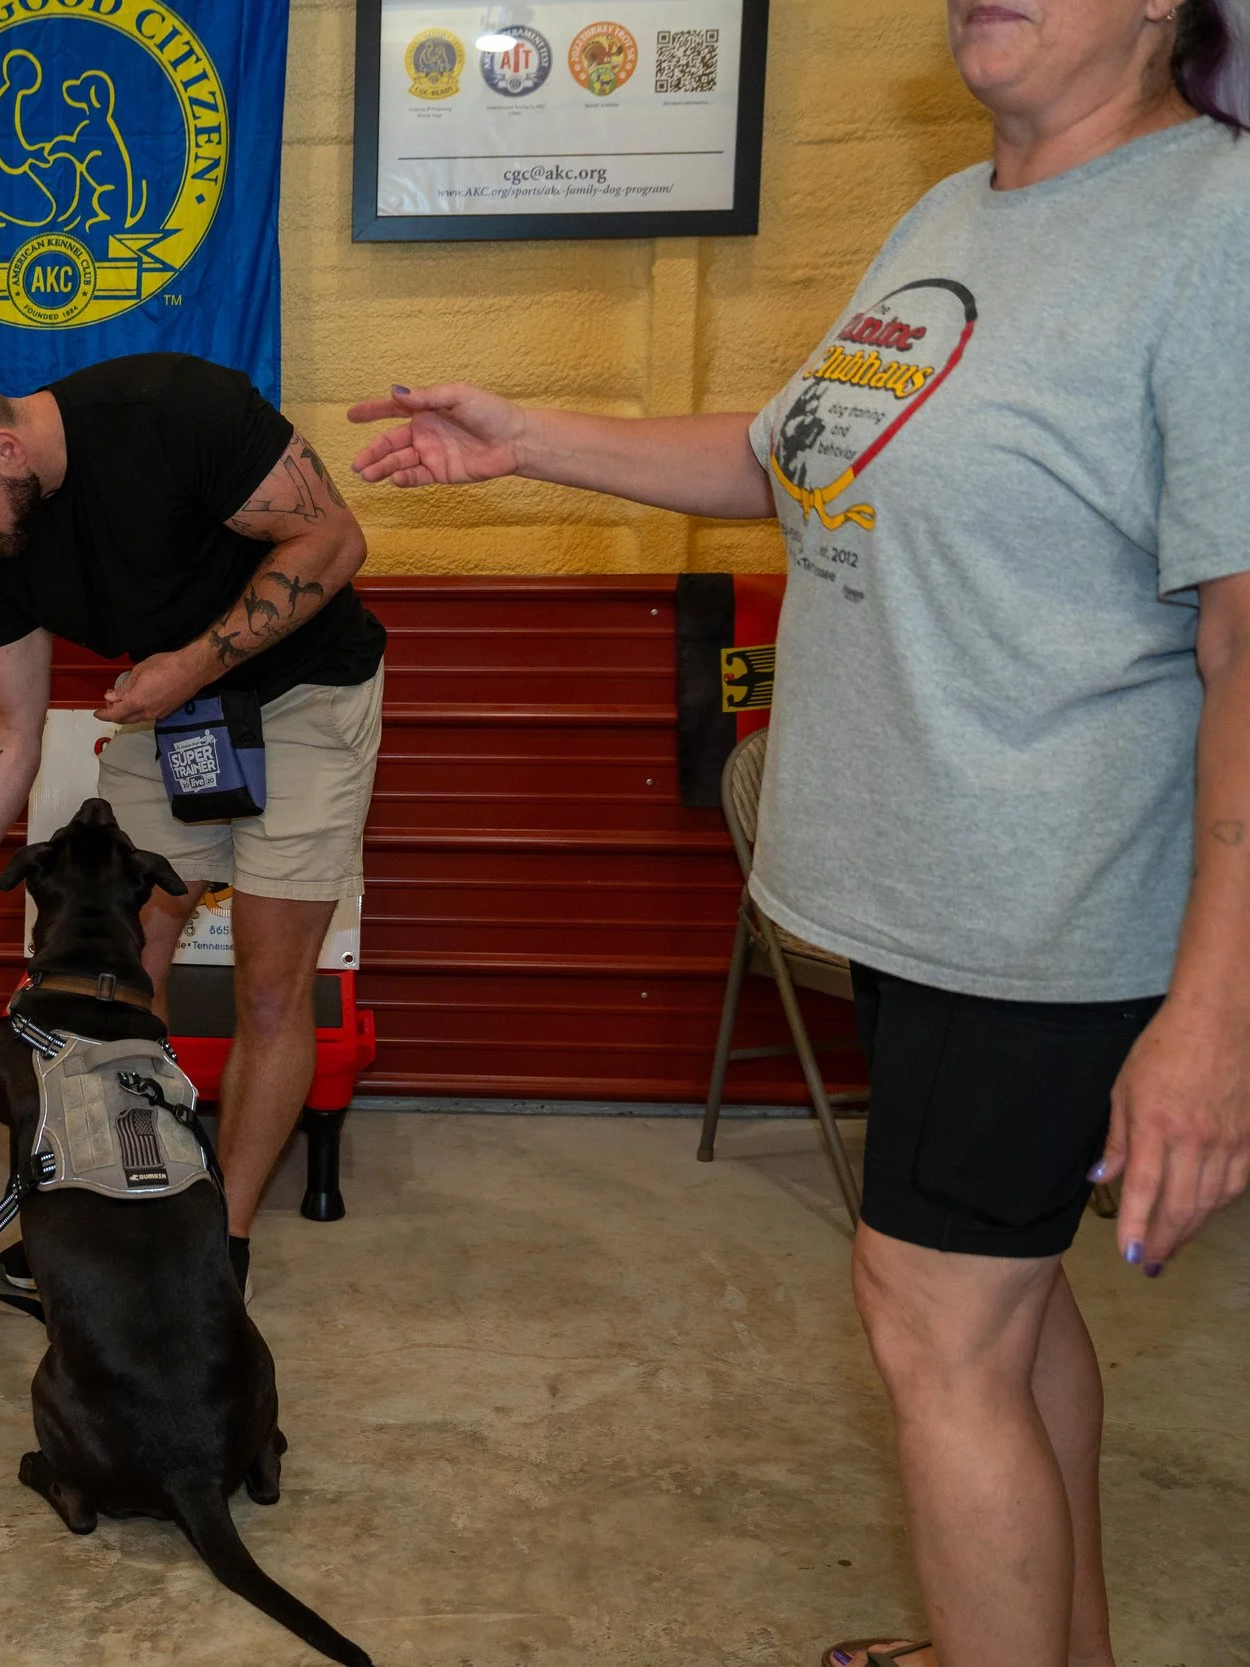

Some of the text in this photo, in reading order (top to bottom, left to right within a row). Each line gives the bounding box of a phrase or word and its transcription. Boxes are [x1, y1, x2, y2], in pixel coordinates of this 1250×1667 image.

[135, 8, 220, 186] CITIZEN
[503, 164, 608, 185] cgc@akc.org
[12, 238, 92, 287] AMERICAN KENNEL CLUB
[31, 265, 73, 293] AKC
[163, 294, 182, 306] TM
[23, 304, 78, 321] FOUNDED 1884
[831, 545, 859, 568] 2012
[171, 745, 215, 768] SUPER
[174, 759, 217, 779] TRAINER
[192, 941, 235, 951] Tennesse
